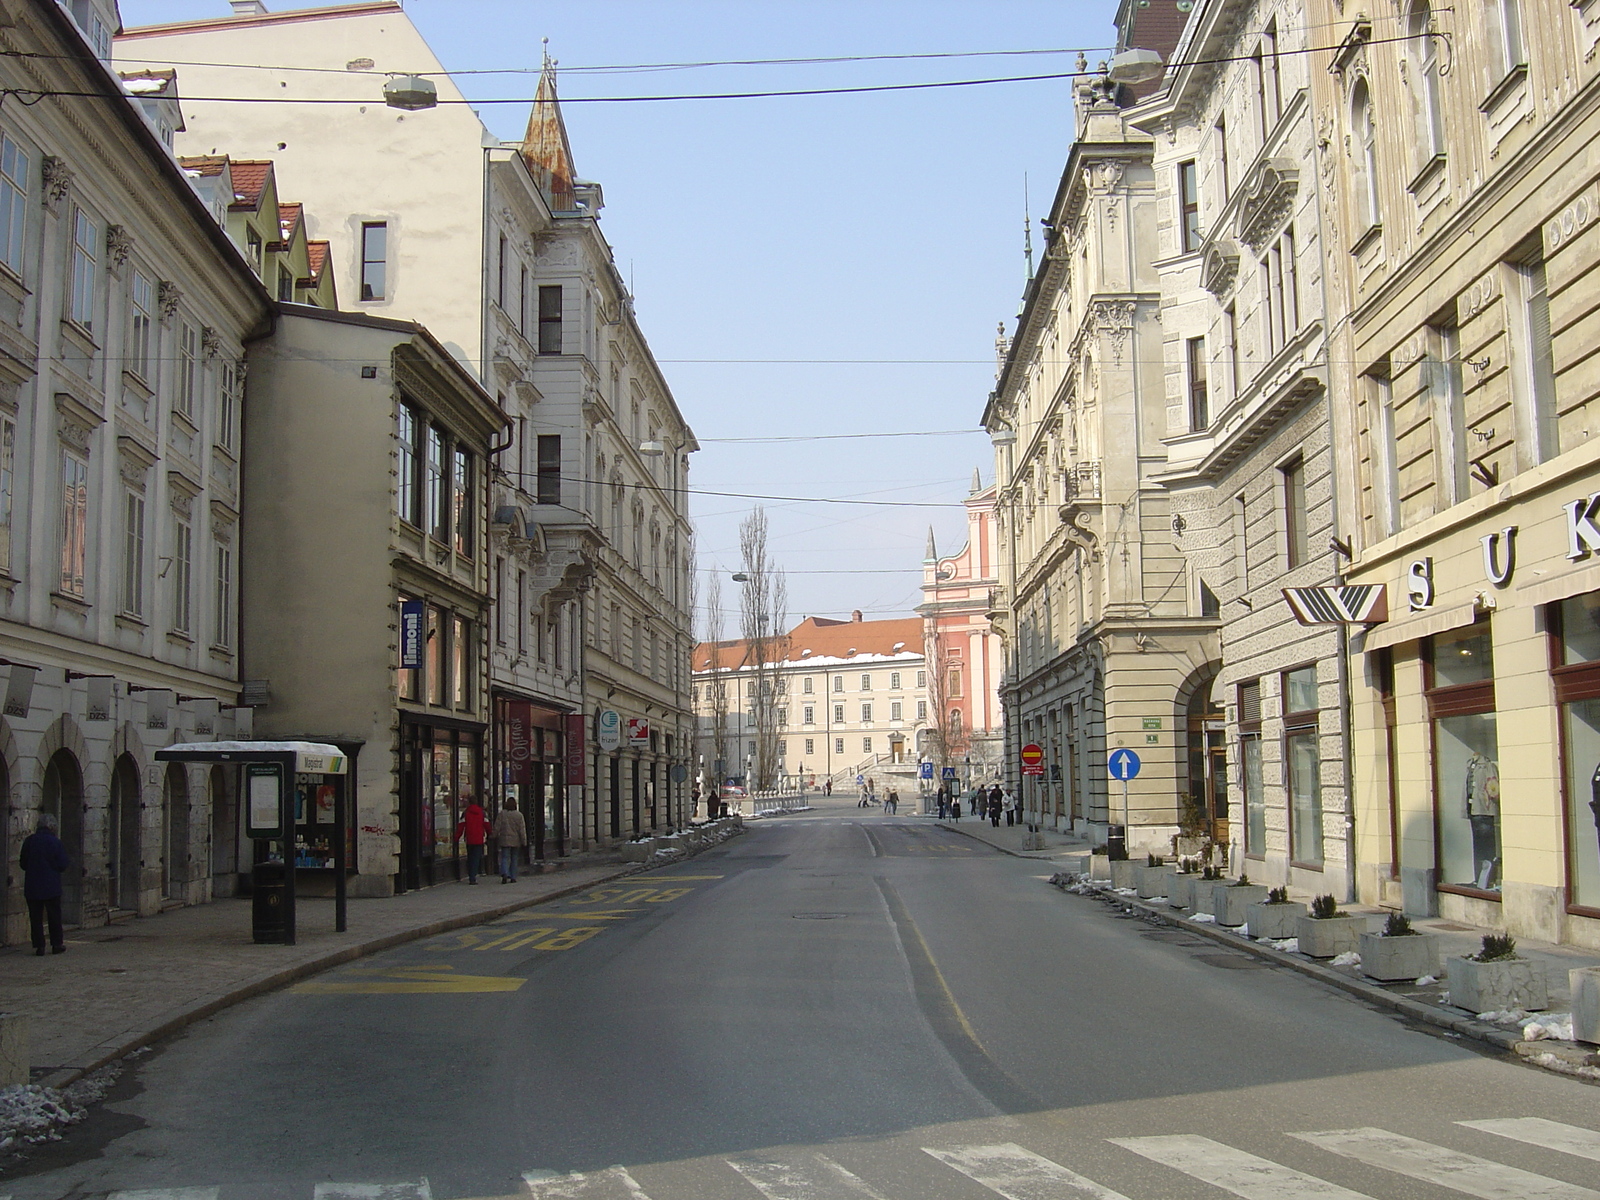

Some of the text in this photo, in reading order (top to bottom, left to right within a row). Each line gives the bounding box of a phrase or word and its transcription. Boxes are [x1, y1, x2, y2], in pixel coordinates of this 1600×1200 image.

[403, 613, 418, 665] limoni
[6, 705, 25, 716] DZS
[89, 712, 107, 720] DZS
[149, 721, 165, 729] DZS
[196, 726, 212, 735] DZS
[569, 887, 694, 904] BUS
[424, 926, 608, 951] BUS
